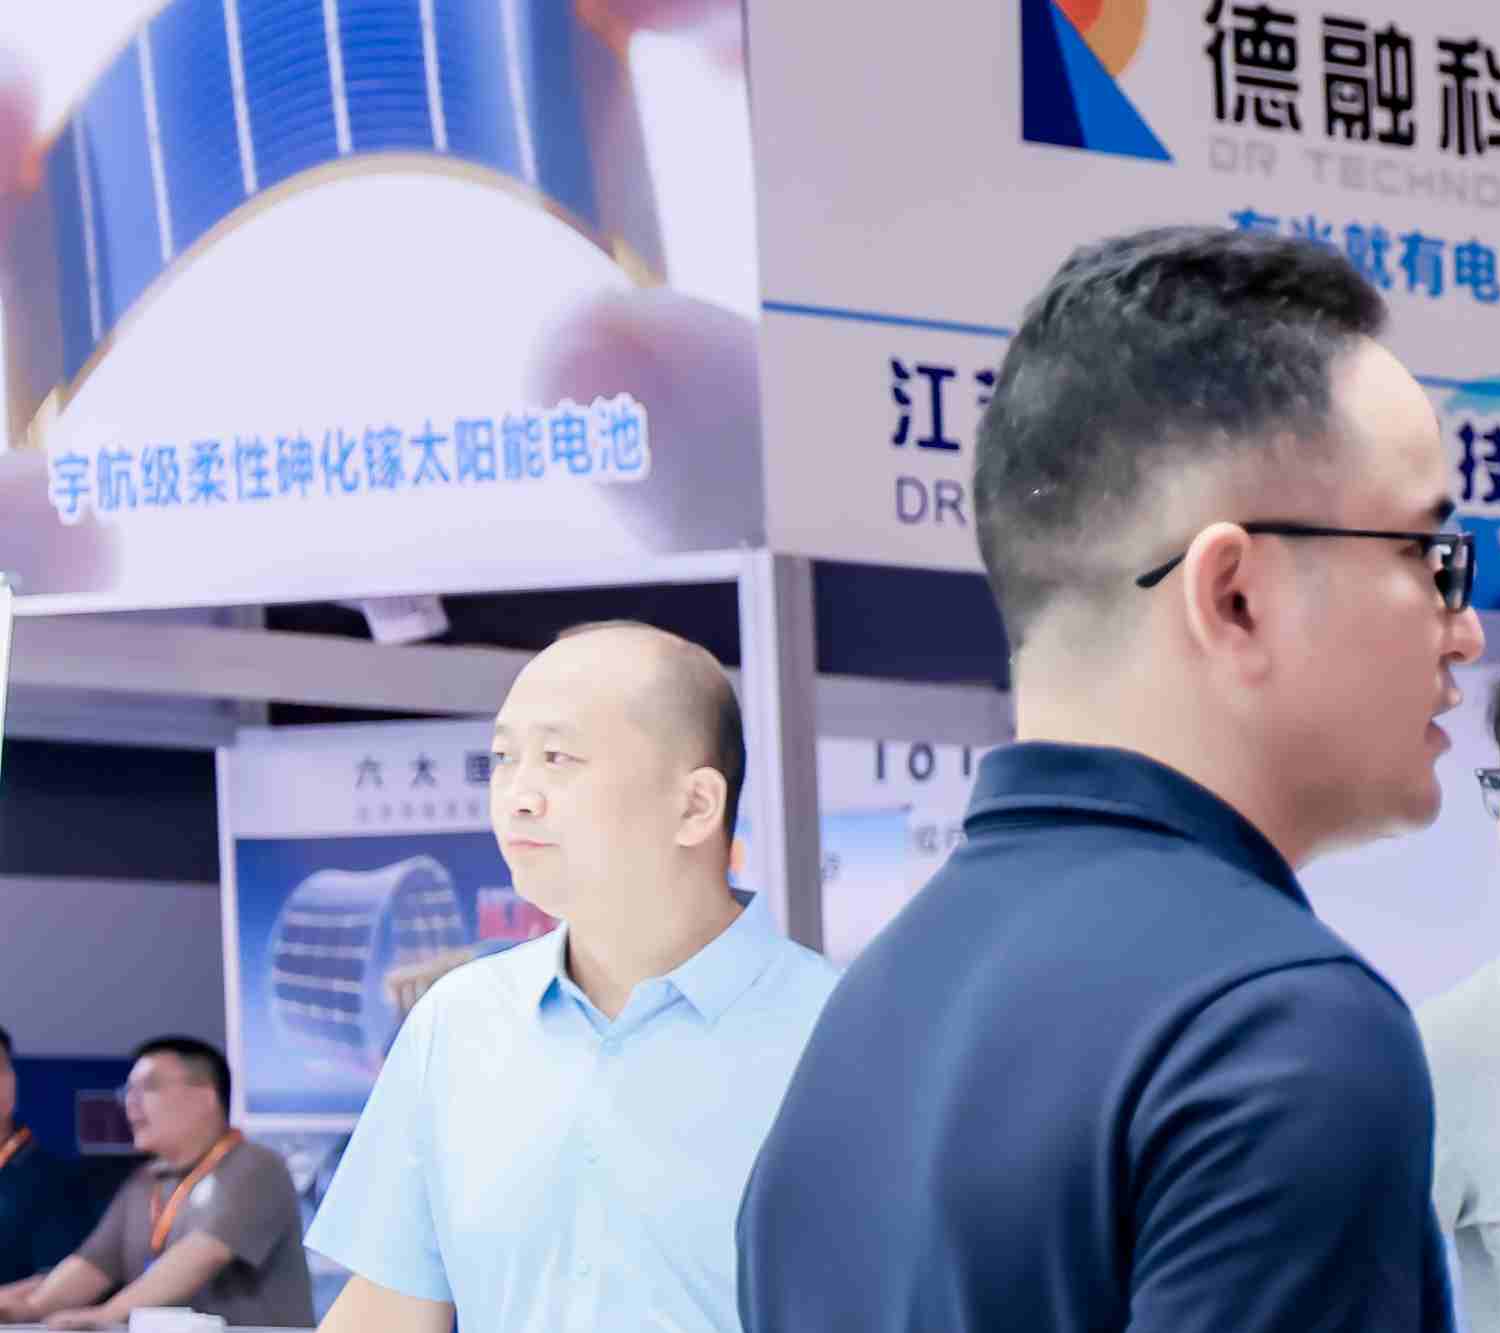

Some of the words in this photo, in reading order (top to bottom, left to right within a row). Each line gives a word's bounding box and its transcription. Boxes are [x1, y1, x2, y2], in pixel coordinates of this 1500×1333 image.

[1207, 136, 1277, 178] DR
[53, 405, 644, 515] 宇航级柔性砷化镓太阳能电池
